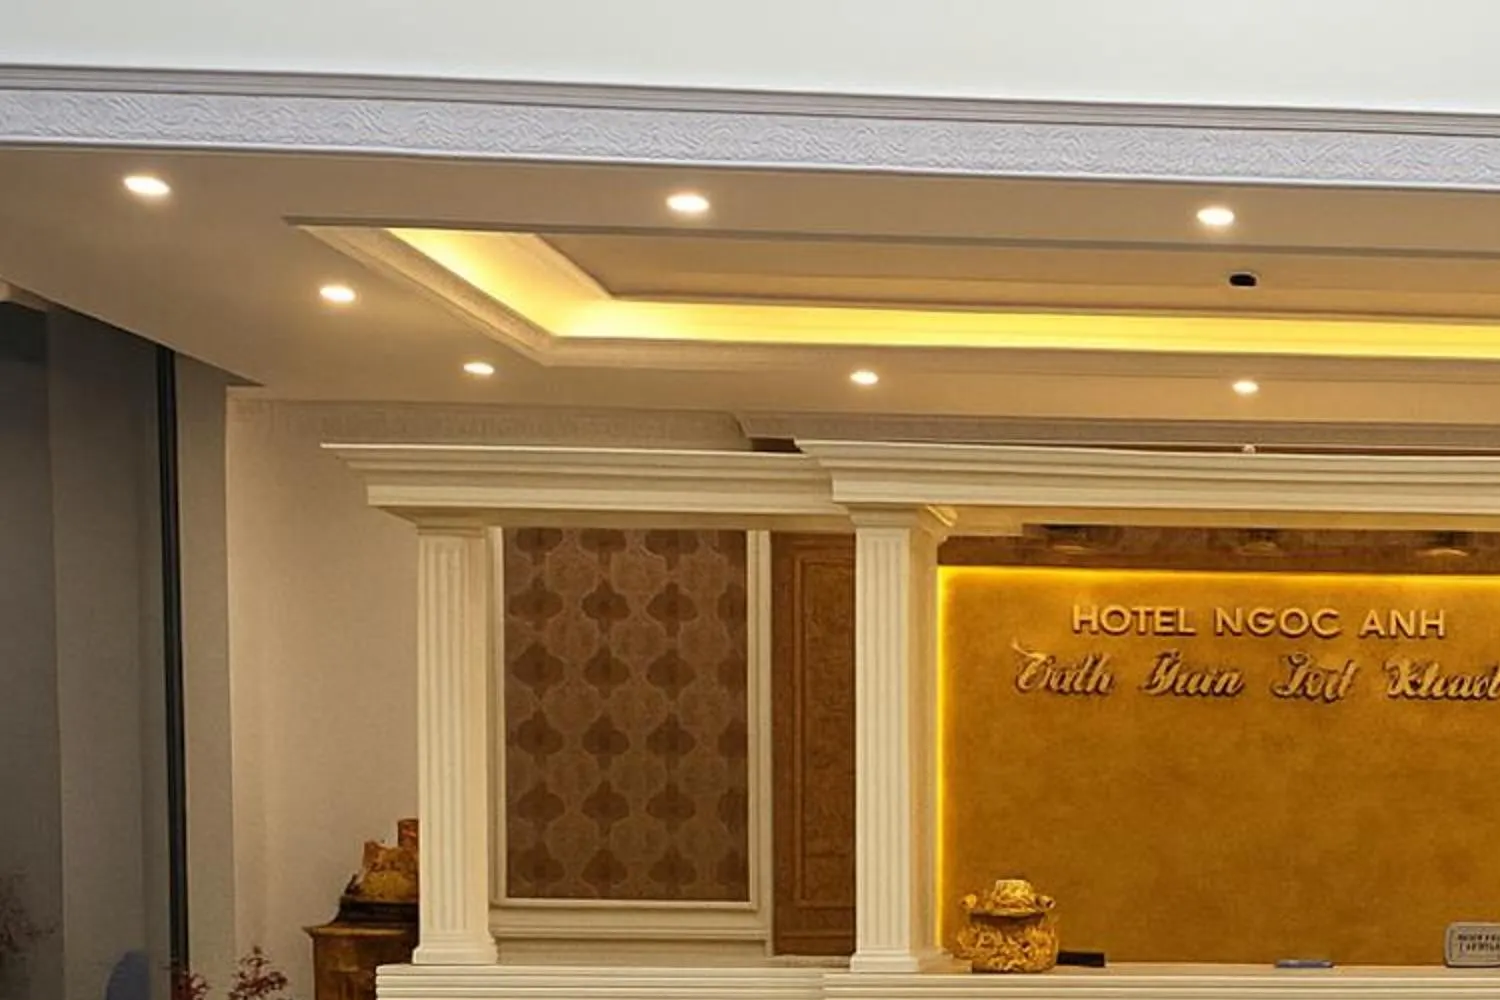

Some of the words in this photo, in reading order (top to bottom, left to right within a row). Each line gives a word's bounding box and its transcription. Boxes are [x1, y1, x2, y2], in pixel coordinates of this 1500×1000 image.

[1072, 603, 1197, 636] HOTEL
[1213, 605, 1342, 640] NGOC
[1357, 607, 1446, 640] ANH
